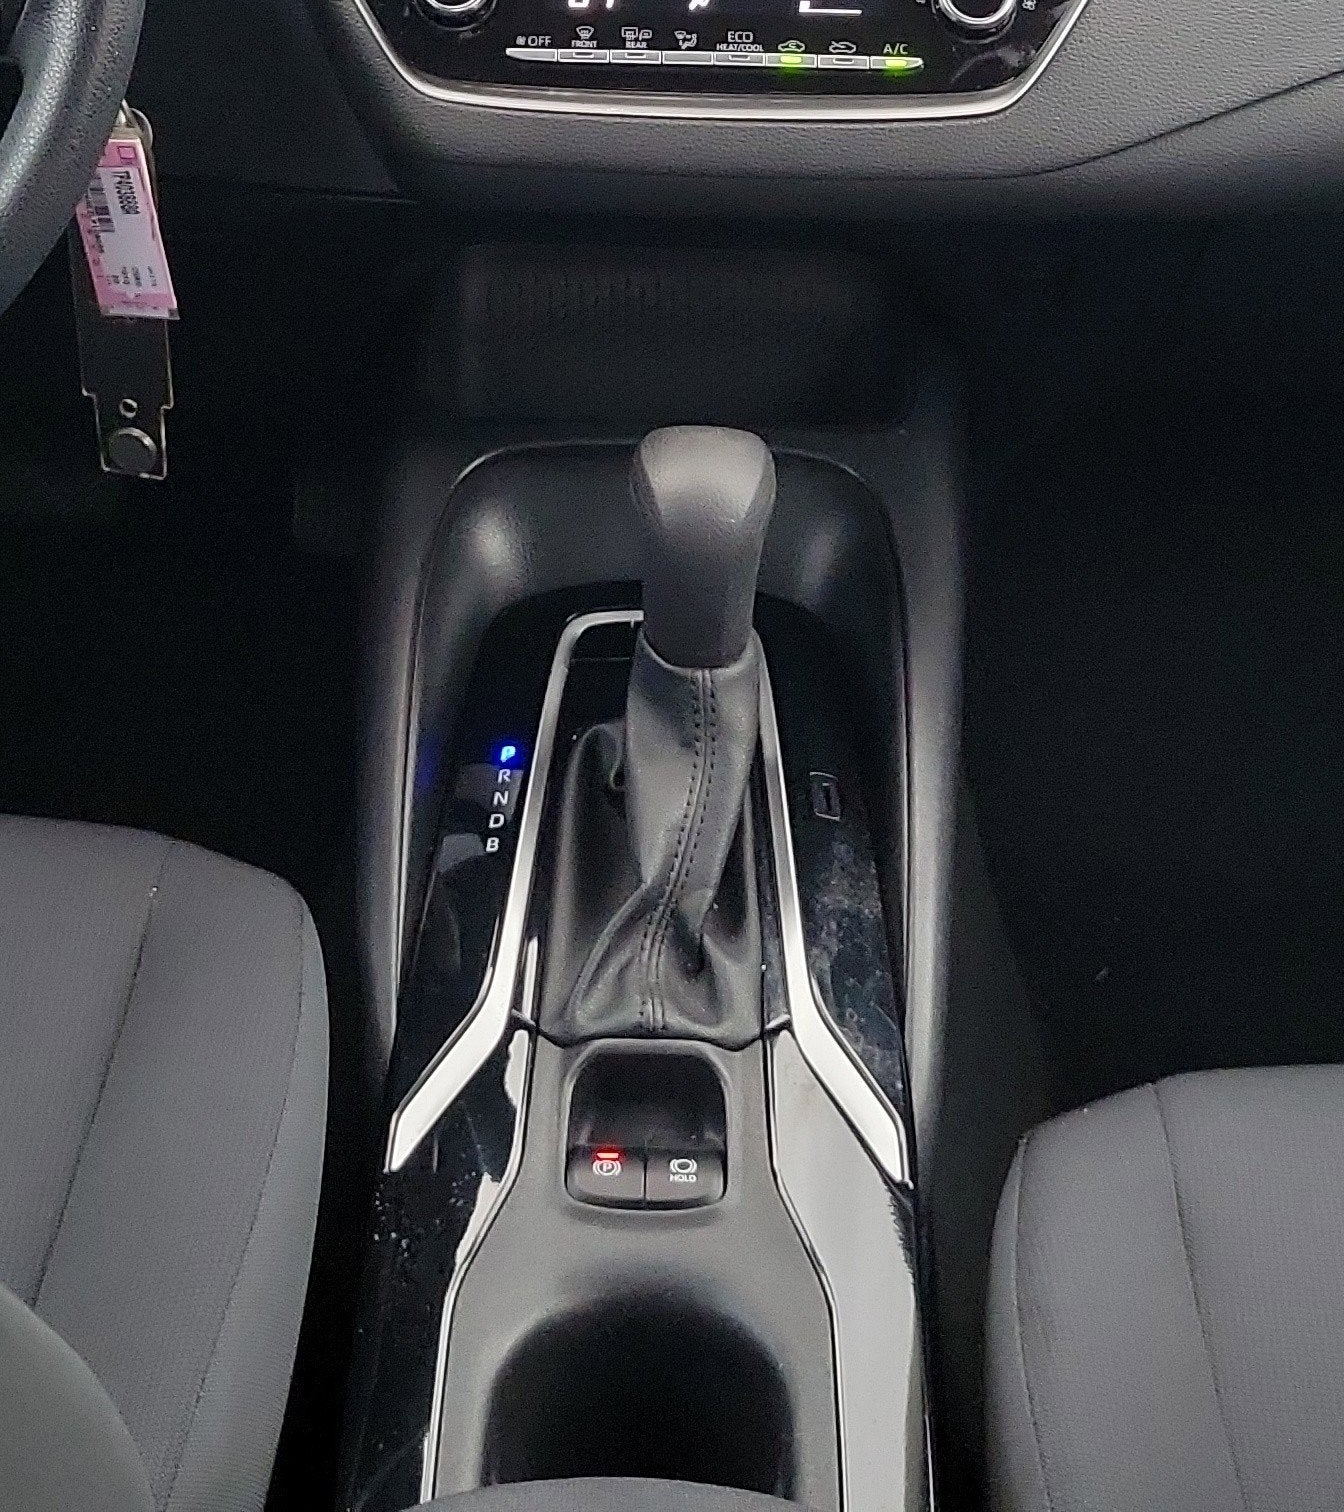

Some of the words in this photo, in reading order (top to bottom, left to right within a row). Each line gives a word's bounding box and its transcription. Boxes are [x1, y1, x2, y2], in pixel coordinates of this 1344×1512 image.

[527, 35, 552, 46] OFF
[727, 30, 754, 43] ECO
[571, 39, 597, 48] FRONT
[625, 39, 647, 48] REAR
[716, 42, 764, 53] HEAT/COOL
[882, 42, 908, 54] A/C
[500, 745, 516, 763] P
[497, 768, 511, 784] R
[493, 790, 509, 807] N
[488, 813, 505, 829] D
[485, 837, 500, 853] B
[669, 1174, 697, 1183] HOLD
